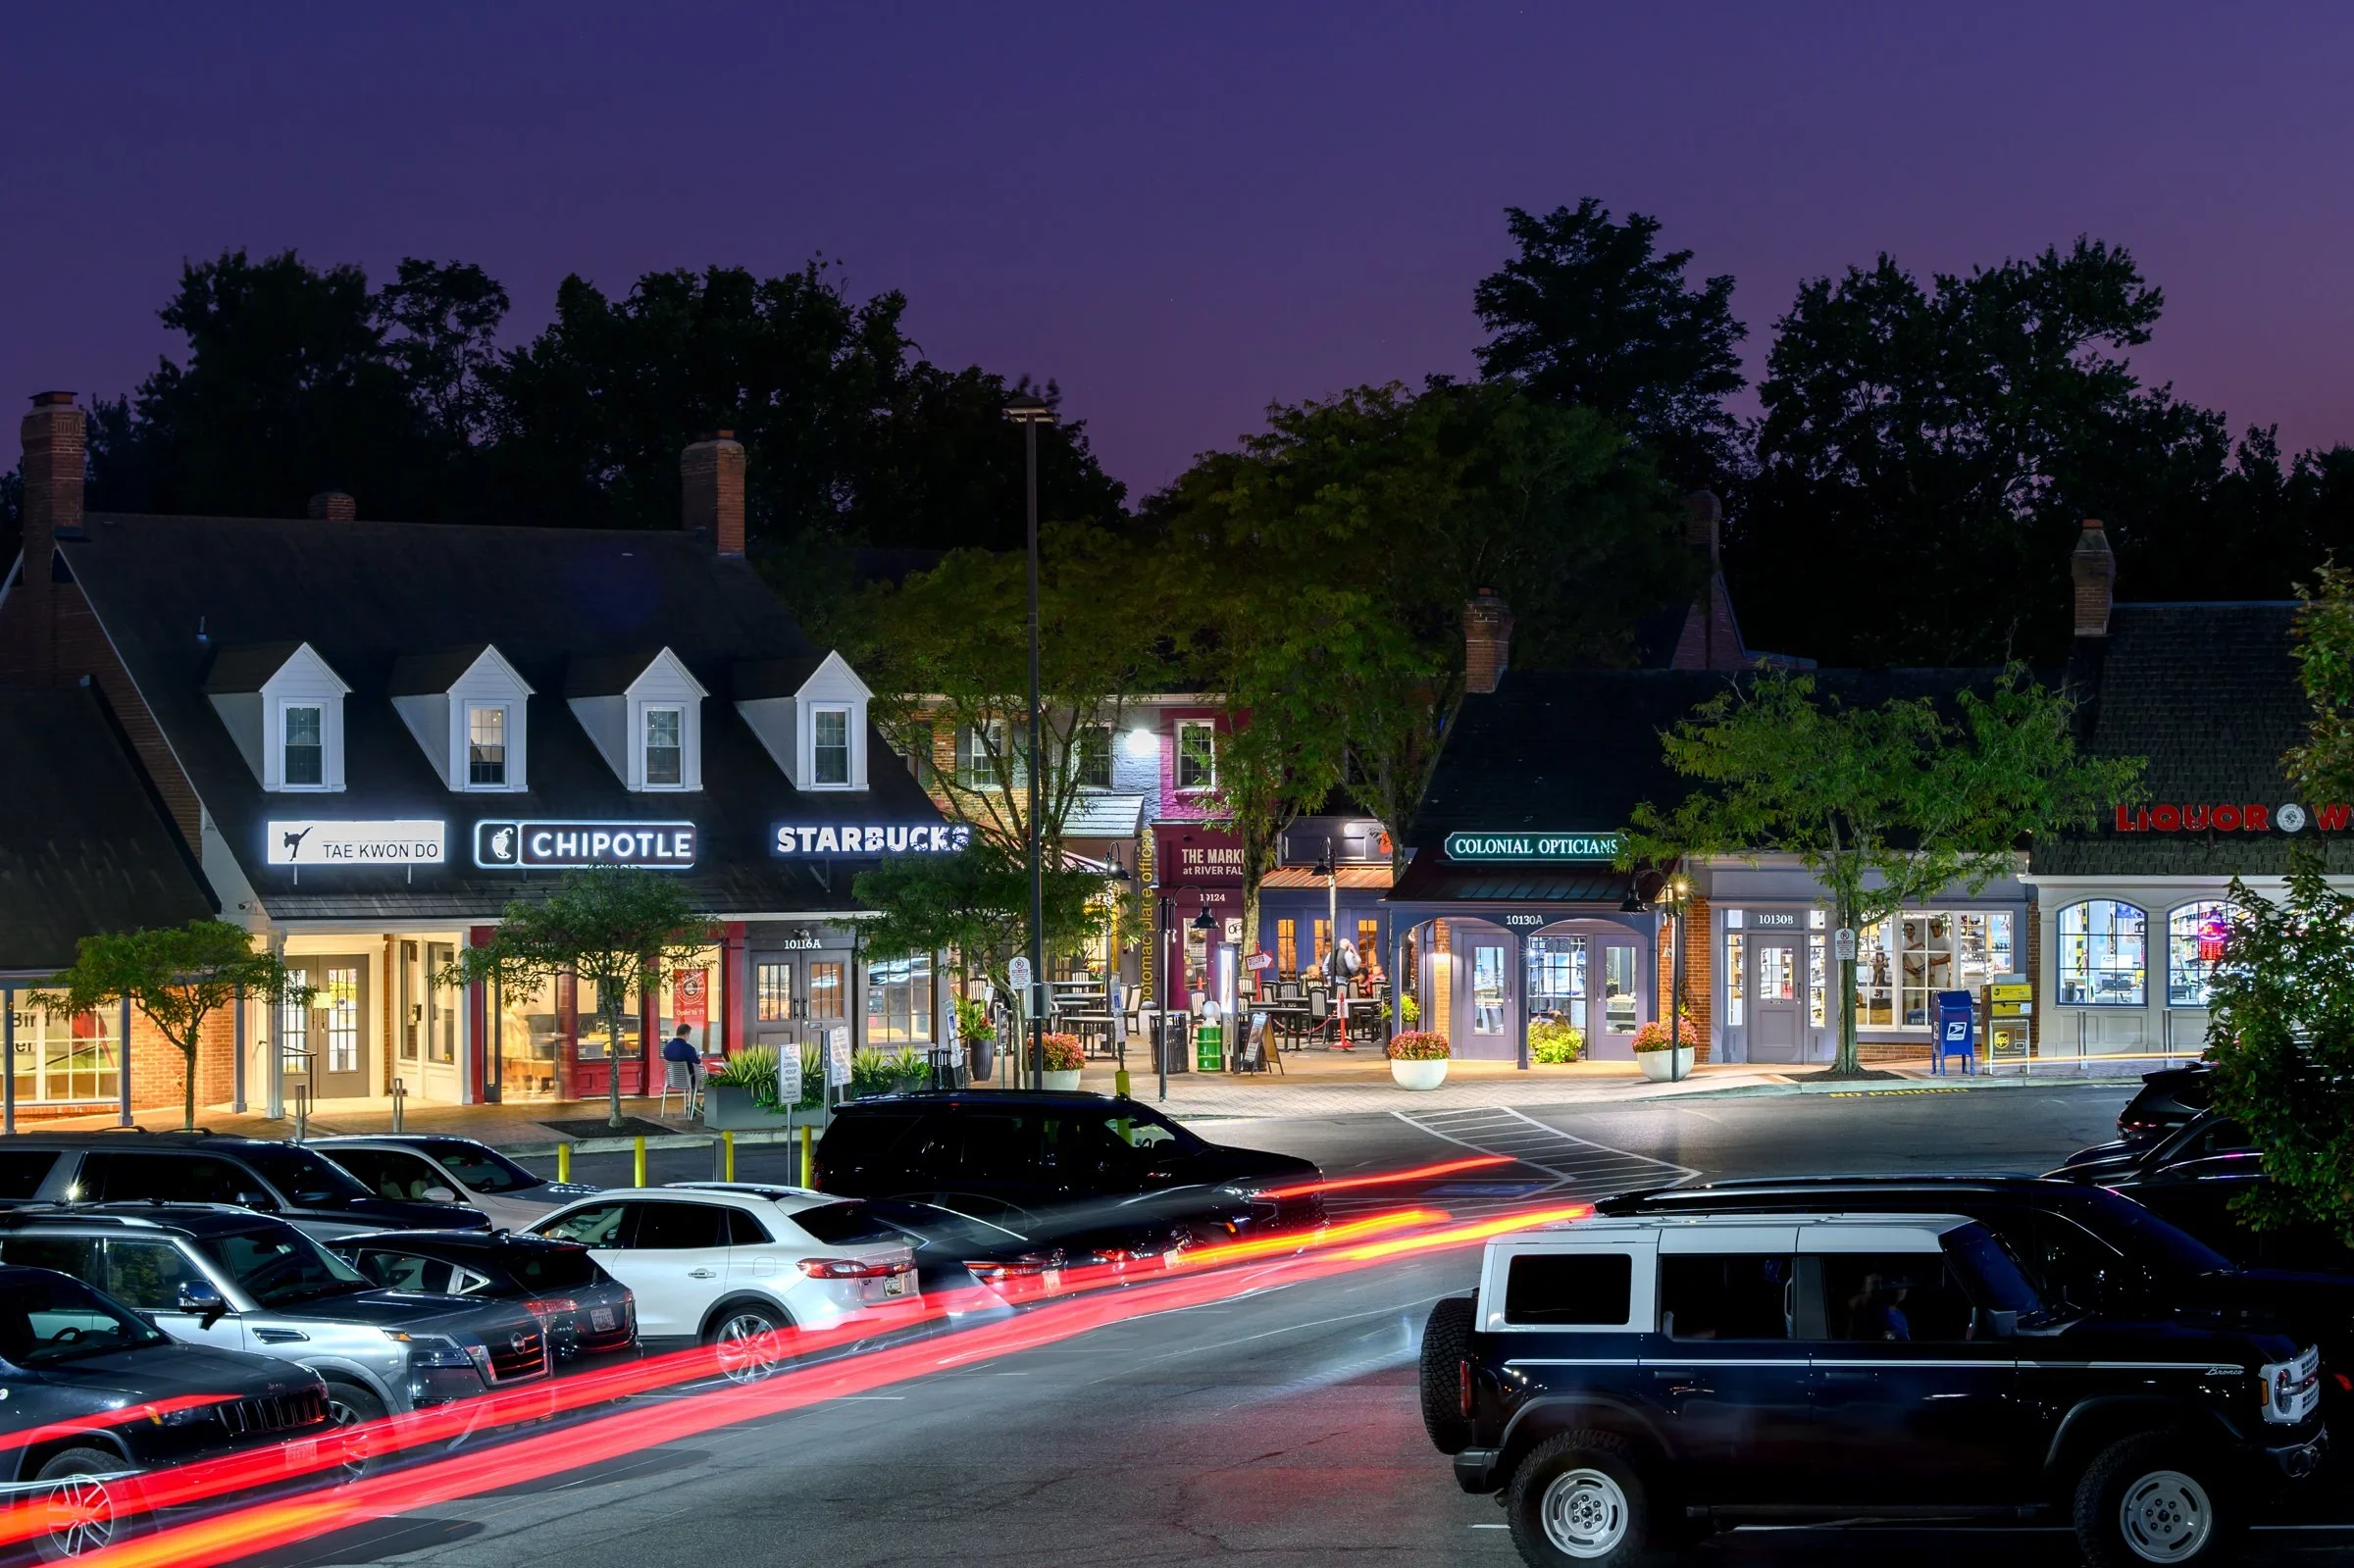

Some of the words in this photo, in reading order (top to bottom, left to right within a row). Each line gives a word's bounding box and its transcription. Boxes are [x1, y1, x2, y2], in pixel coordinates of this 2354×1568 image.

[2116, 804, 2271, 832] LIQUOR
[2312, 804, 2354, 832] W
[533, 833, 691, 857] CHIPOTLE
[777, 826, 969, 852] STARBUCKS
[1455, 838, 1534, 854] COLONIAL
[1538, 838, 1618, 854] OPTICIANS
[323, 844, 353, 858] TAE
[359, 843, 409, 858] KWON
[415, 843, 438, 857] DO
[1181, 848, 1204, 864] THE
[1207, 848, 1245, 864] MARK
[1195, 866, 1224, 875] RIVER
[1225, 866, 1244, 876] FAL
[1200, 893, 1226, 902] 10124
[1139, 886, 1156, 932] place
[1506, 914, 1544, 925] 10130A
[1759, 914, 1794, 925] 10130B
[1228, 923, 1243, 935] OP
[784, 938, 822, 949] 10116A
[1141, 935, 1155, 1002] potomac
[1868, 1087, 1970, 1097] PARKING
[2204, 1366, 2245, 1376] Bronco
